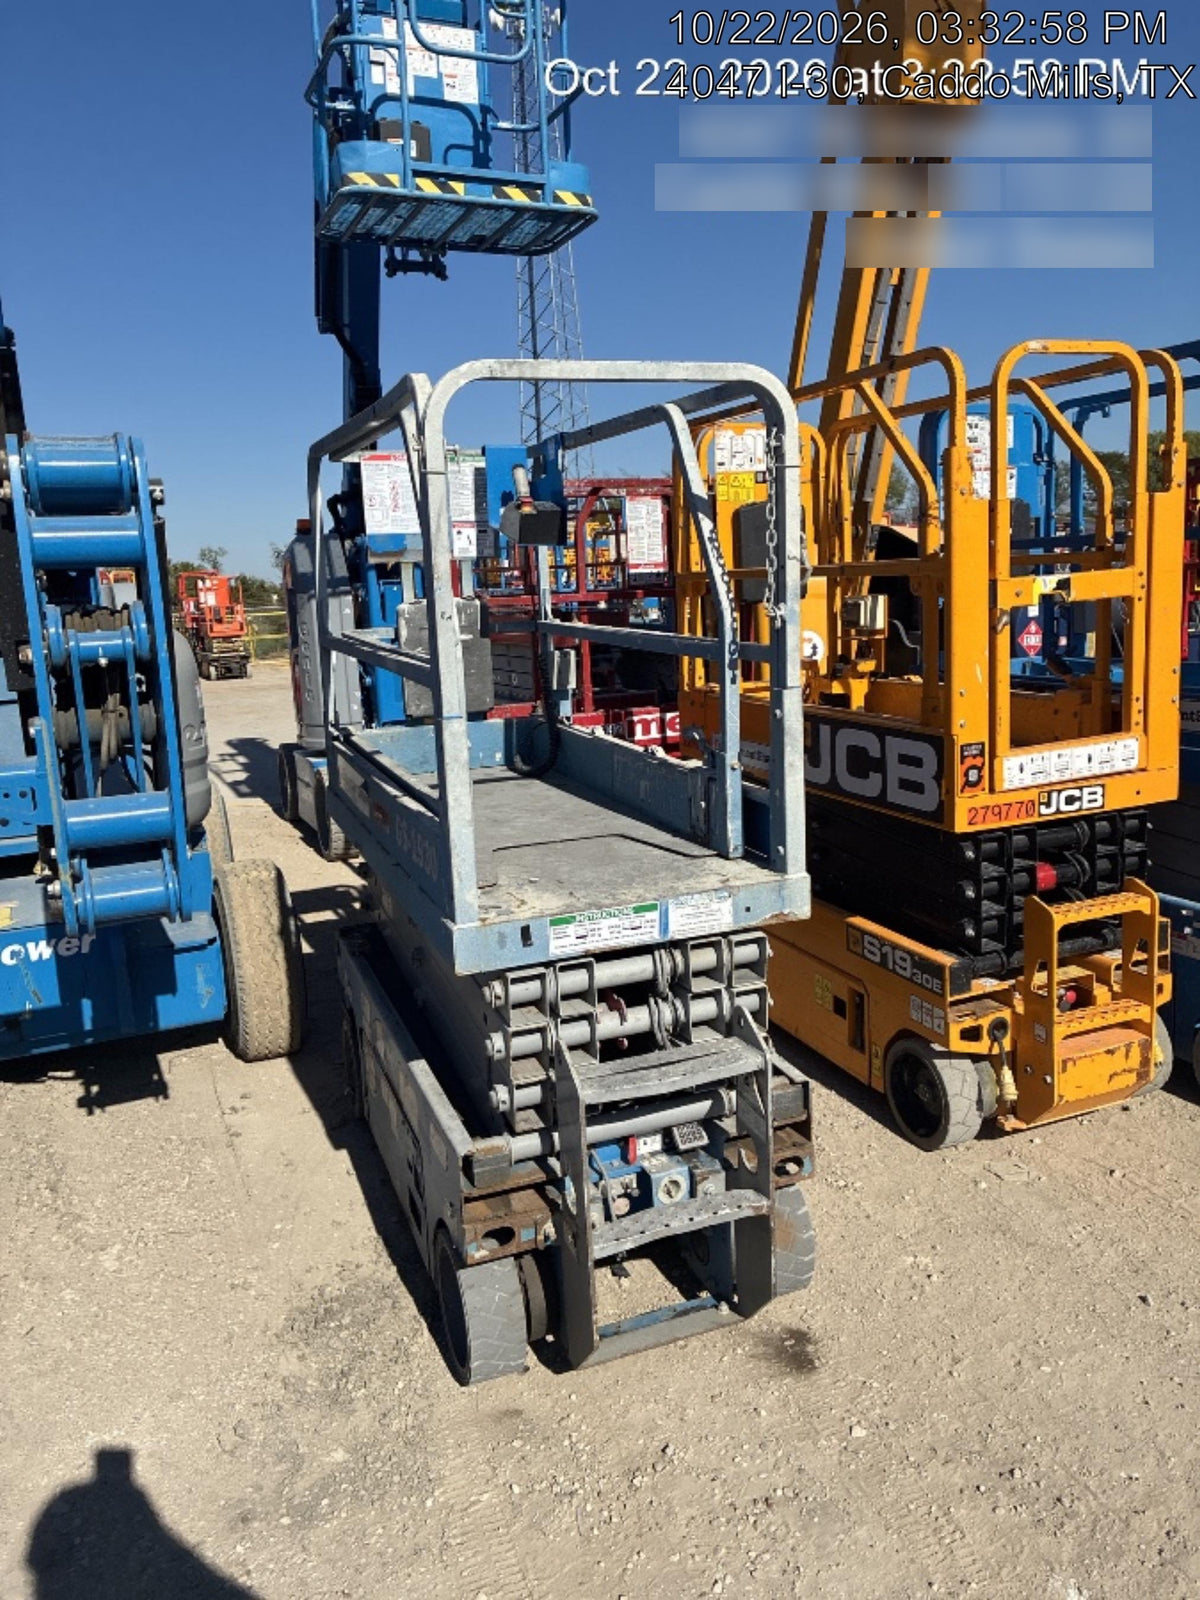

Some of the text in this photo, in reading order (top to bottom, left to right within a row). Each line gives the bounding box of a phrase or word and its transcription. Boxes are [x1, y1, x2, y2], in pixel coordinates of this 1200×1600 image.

[804, 723, 940, 813] JCB
[967, 800, 1036, 826] 279770
[1039, 785, 1104, 815] JCB
